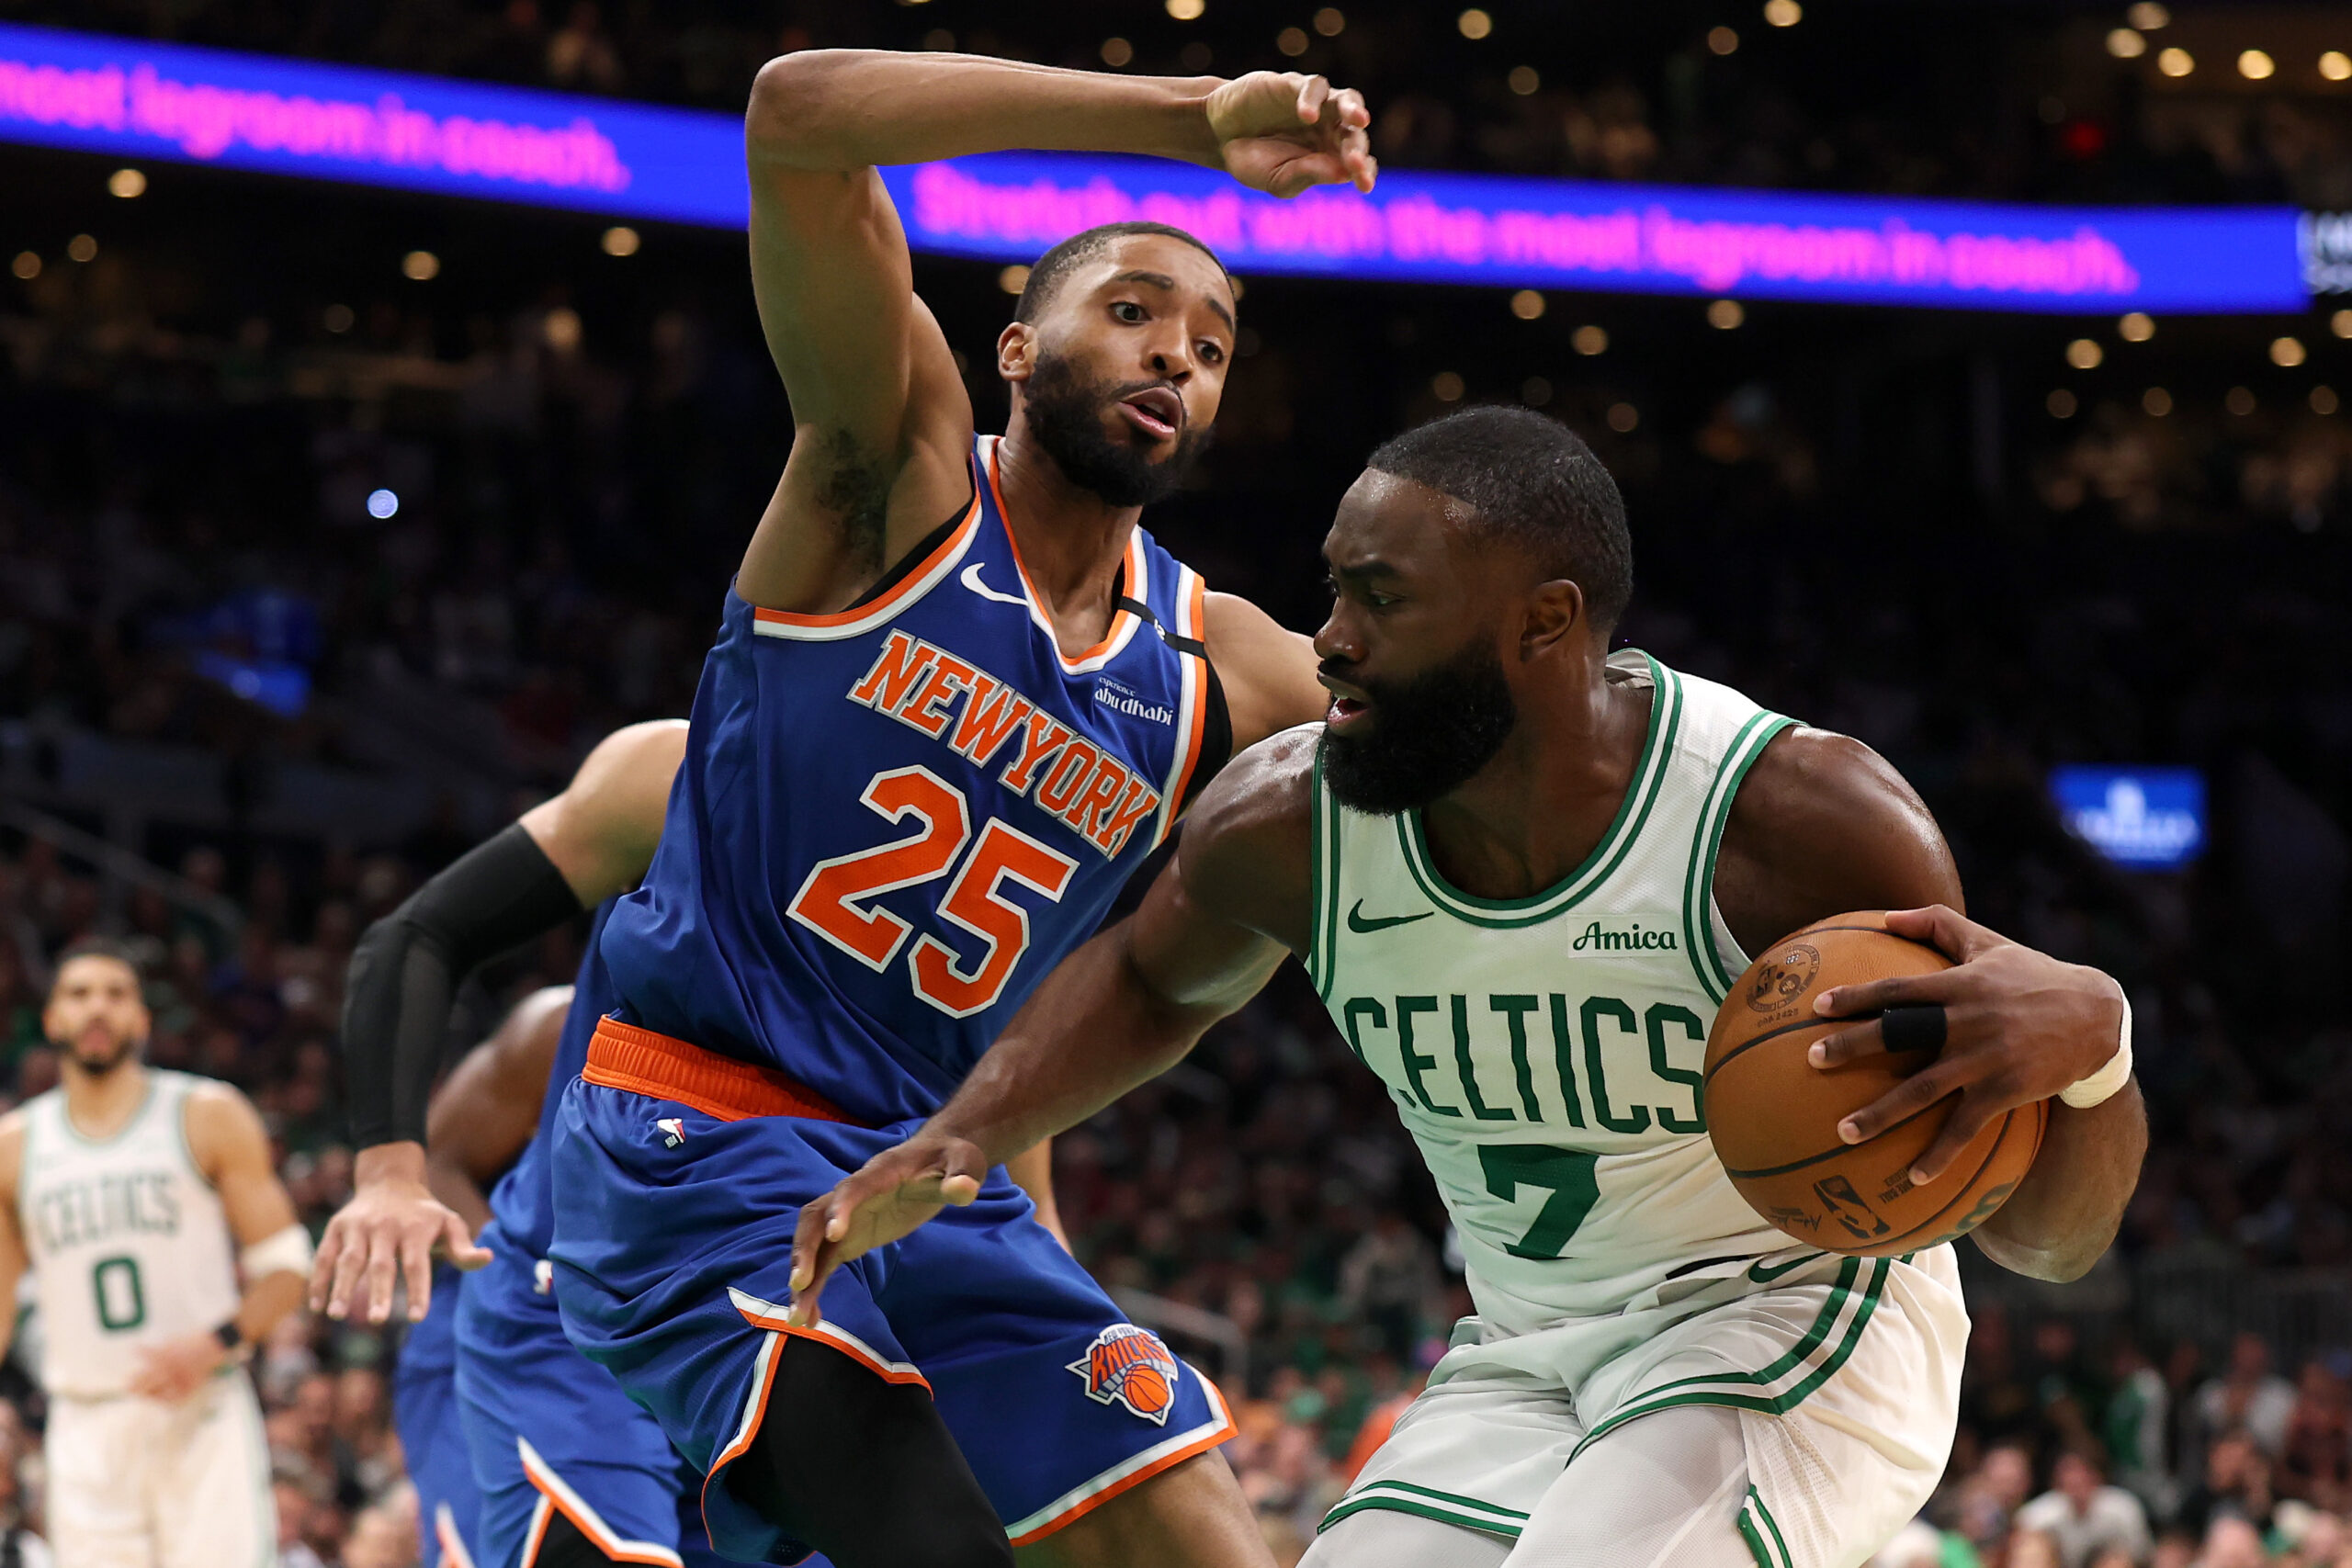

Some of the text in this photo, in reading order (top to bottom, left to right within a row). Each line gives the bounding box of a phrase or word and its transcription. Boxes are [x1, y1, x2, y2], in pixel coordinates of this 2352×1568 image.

[128, 68, 374, 155] legroom
[377, 97, 435, 163] in
[1246, 191, 1378, 255] with
[1381, 197, 1486, 262] the
[1488, 212, 1642, 269] most
[1643, 210, 1881, 288] legroom
[1883, 229, 1940, 282] in
[1095, 688, 1173, 725] abu dhabi
[786, 764, 1080, 1019] 25
[1573, 921, 1678, 951] Amica
[1343, 992, 1707, 1134] CELTICS
[38, 1171, 181, 1253] CELTICS
[1477, 1143, 1601, 1259] 7
[93, 1255, 147, 1332] 0
[1091, 1332, 1175, 1393] KNICKS
